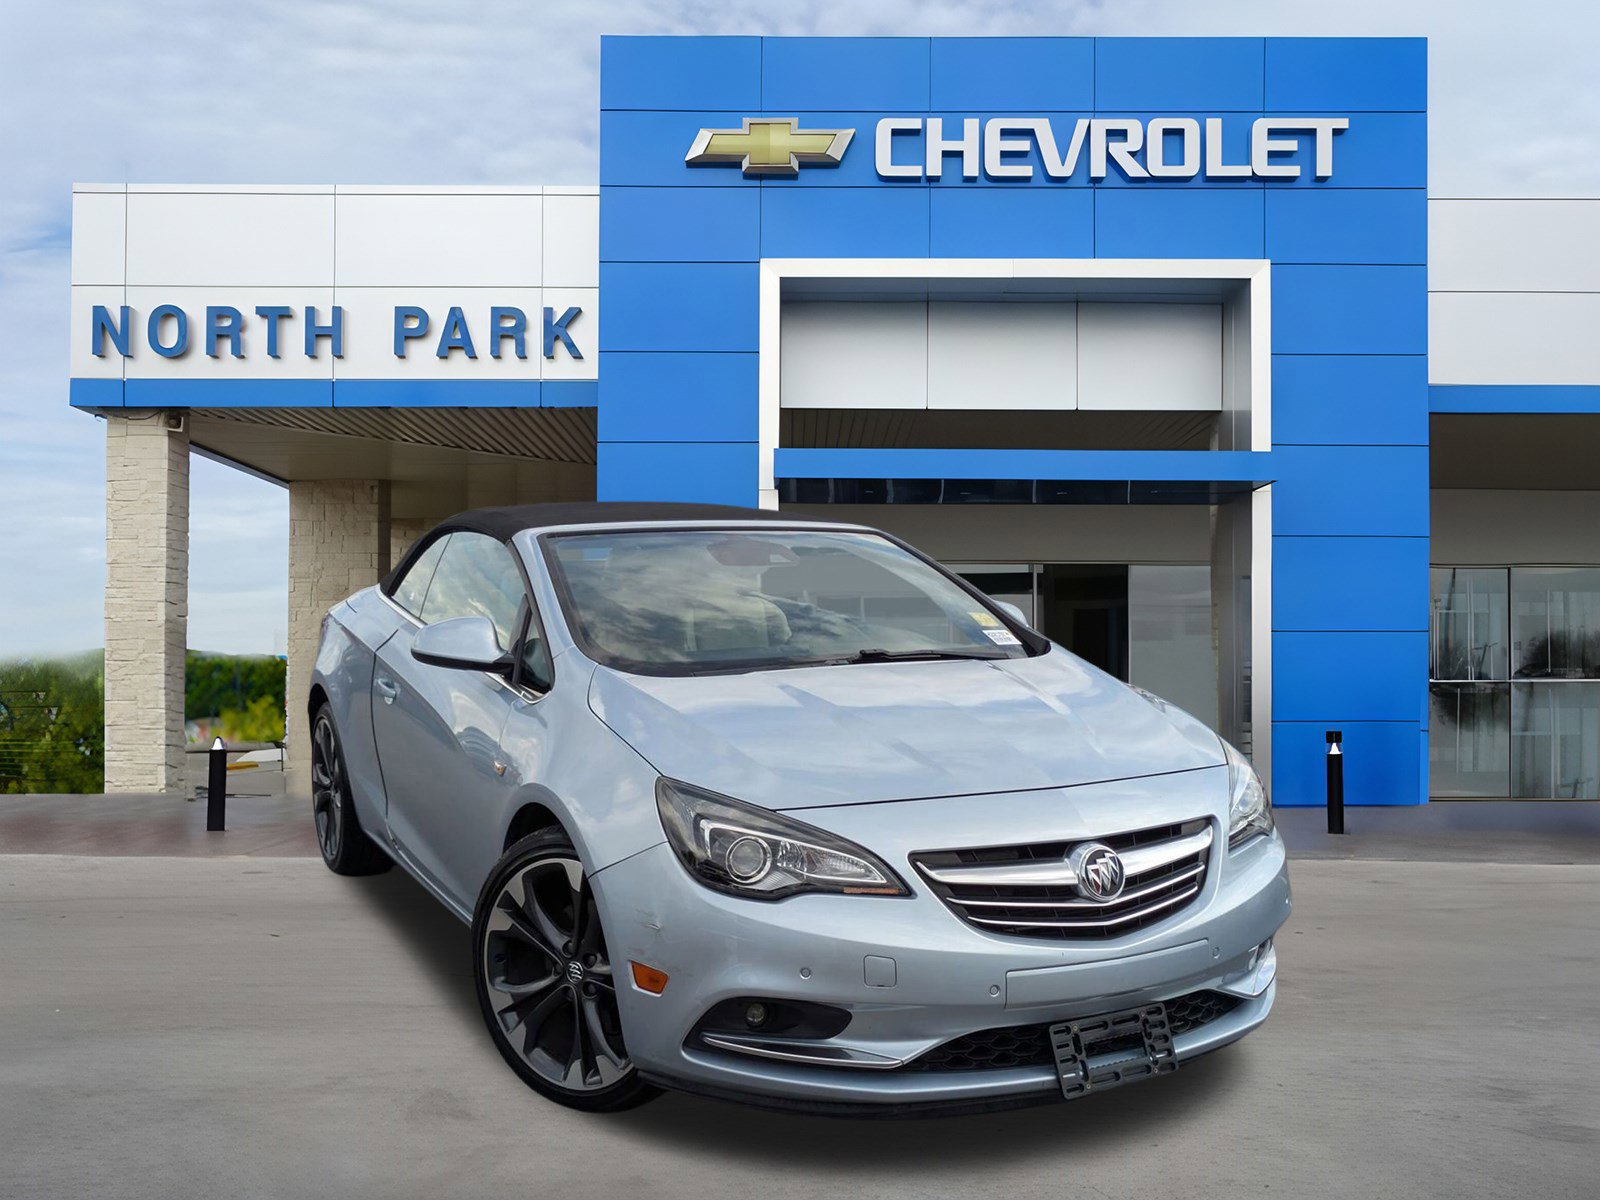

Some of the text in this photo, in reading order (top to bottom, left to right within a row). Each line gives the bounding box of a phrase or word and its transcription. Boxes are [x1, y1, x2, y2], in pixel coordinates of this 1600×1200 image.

[874, 116, 1349, 179] CHEVROLET
[91, 303, 585, 360] NORTH PARK
